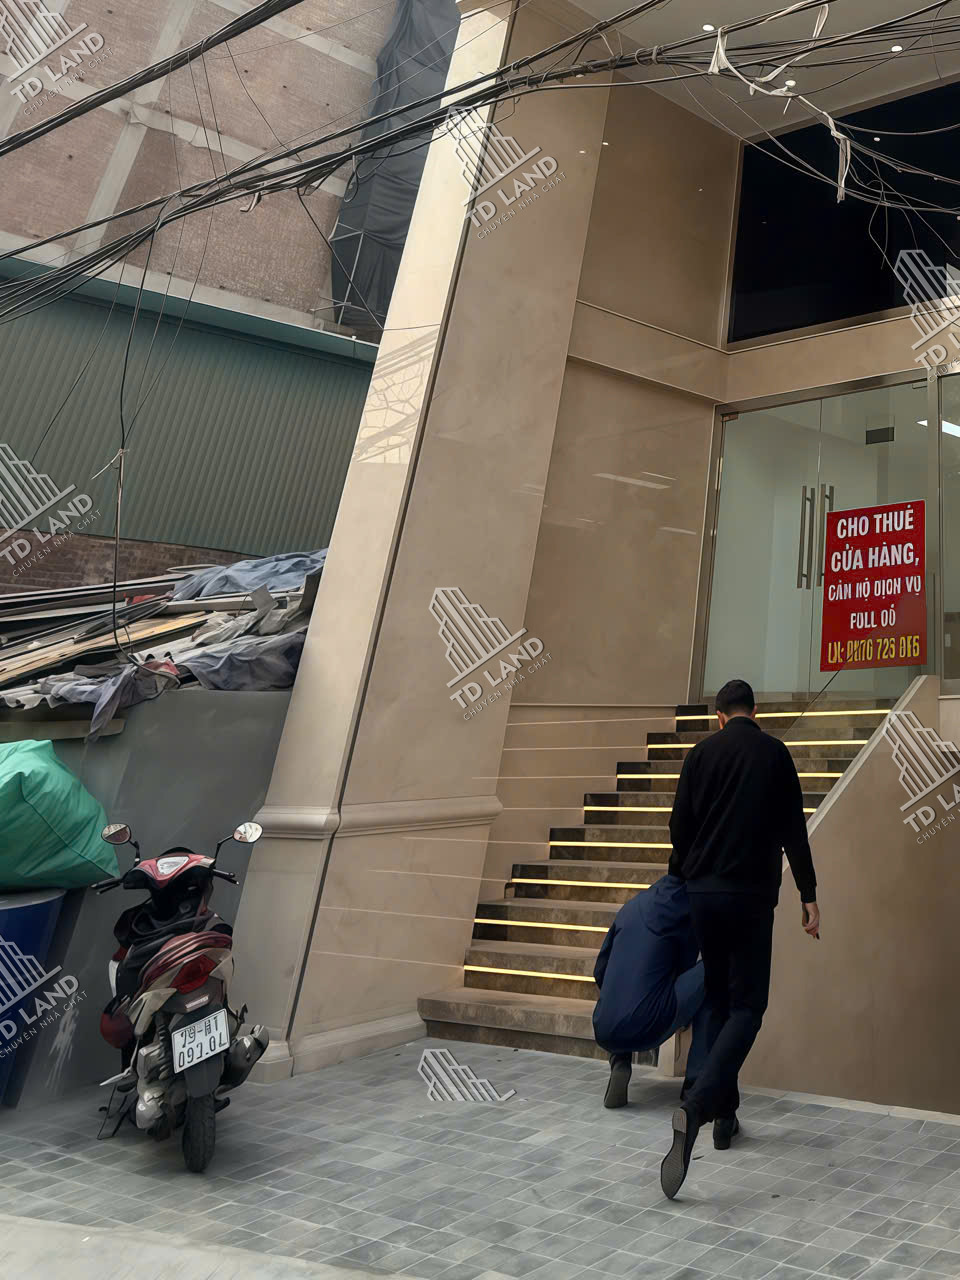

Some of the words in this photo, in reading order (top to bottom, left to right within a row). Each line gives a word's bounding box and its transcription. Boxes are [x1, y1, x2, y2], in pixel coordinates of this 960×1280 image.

[836, 516, 869, 539] CHO
[873, 504, 914, 534] THUÊ
[831, 543, 863, 573] CỬA
[905, 575, 922, 596] VỤ
[850, 610, 877, 629] FULL
